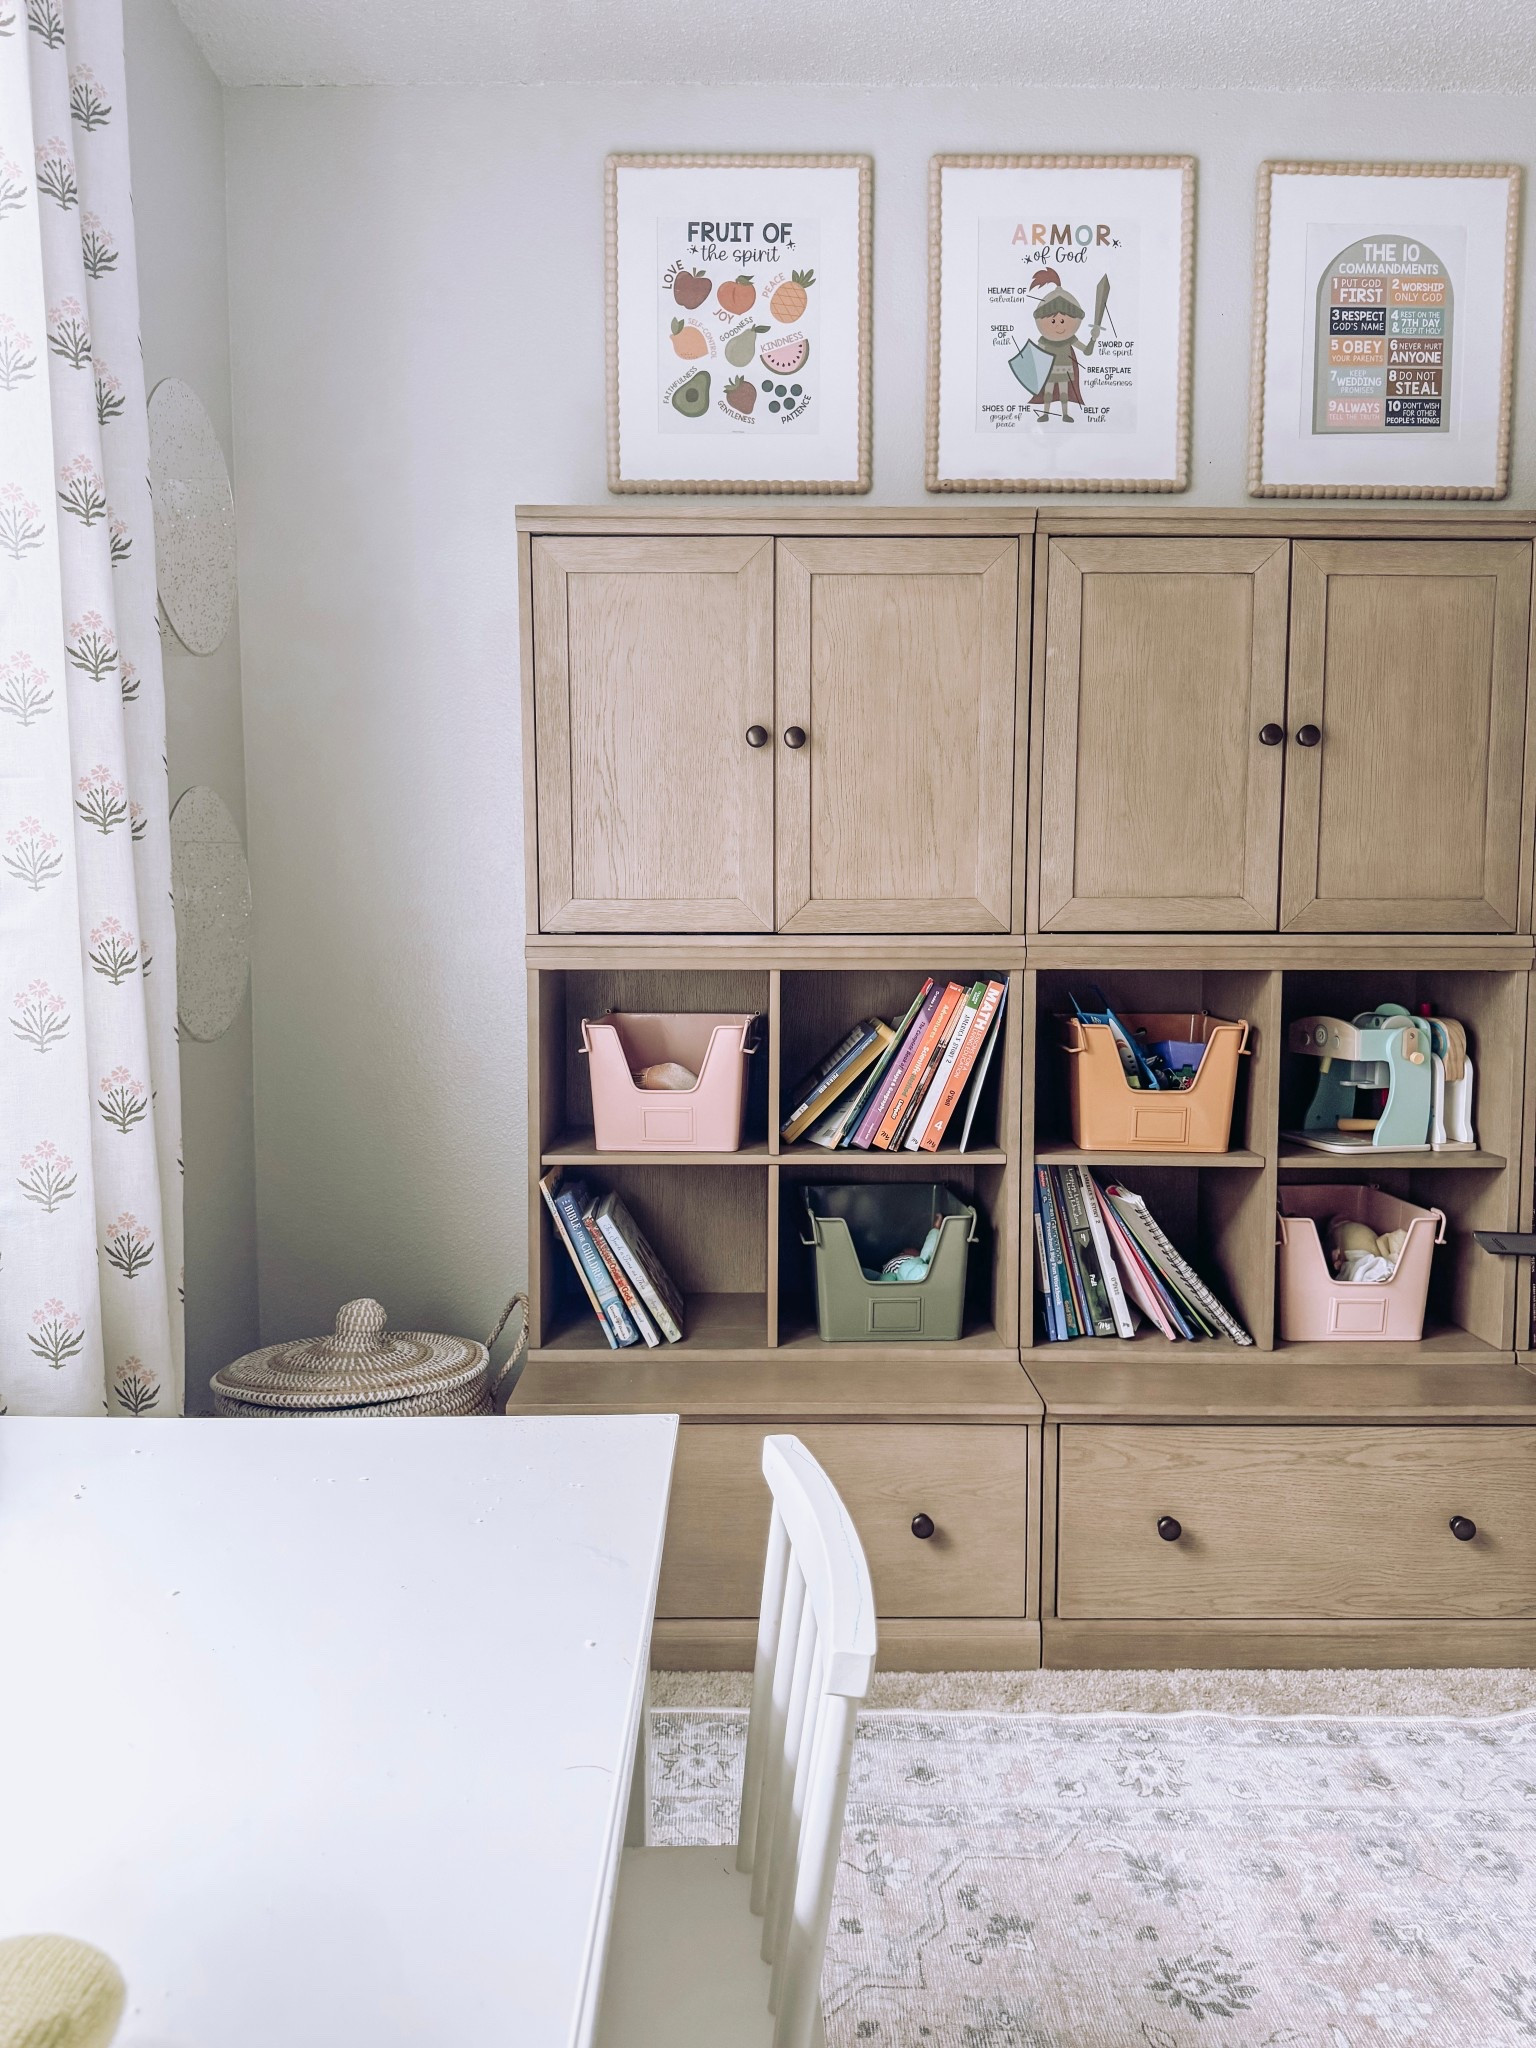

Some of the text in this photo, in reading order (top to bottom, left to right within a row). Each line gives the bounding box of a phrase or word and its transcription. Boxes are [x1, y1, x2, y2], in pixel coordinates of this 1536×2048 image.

[688, 222, 792, 243] FRUIT OF
[1012, 224, 1110, 246] ARMOR
[701, 244, 780, 267] the spirit
[1033, 246, 1088, 264] of God
[1363, 244, 1420, 261] THE 10
[662, 260, 684, 289] LOVE
[1339, 263, 1439, 275] COMMANDMENTS
[762, 272, 786, 299] PEACE
[1333, 278, 1381, 289] 1 PUT GOD
[1392, 279, 1444, 291] 2 WORSHIP
[990, 295, 1024, 303] salvation
[1340, 288, 1383, 302] FIRST
[1395, 293, 1442, 301] ONLY GOD
[713, 309, 734, 324] JOY
[1332, 310, 1384, 321] 3 RESPECT
[1391, 310, 1399, 320] 4
[720, 316, 754, 342] GOODNESS
[1362, 323, 1384, 331] NAME
[1392, 322, 1399, 332] &
[1401, 319, 1440, 328] 7TH DAY
[688, 318, 717, 359] SELF-CONTROL
[760, 331, 804, 352] KINDNESS
[1390, 340, 1397, 350] 6
[1112, 349, 1133, 358] spirit
[1332, 340, 1382, 353] 5 OBEY
[1390, 352, 1441, 363] ANYONE
[1330, 371, 1337, 381] 7
[1337, 378, 1381, 386] WEDDING
[1389, 371, 1436, 381] 8 DO NOT
[663, 366, 698, 403] FAITHFULNESS
[1396, 382, 1438, 395] STEAL
[718, 401, 755, 424] GENTLENESS
[781, 394, 811, 424] PATIENCE
[1329, 401, 1380, 413] 9 ALWAYS
[1388, 401, 1400, 411] 10
[990, 413, 1012, 421] gospel
[974, 988, 999, 1031] MATH
[930, 1004, 948, 1038] Adventures
[907, 1029, 921, 1050] Complete
[969, 1030, 982, 1052] LESSONS
[901, 1050, 910, 1063] Book
[910, 1045, 929, 1075] Scientific
[953, 1045, 970, 1078] EDUCATION
[891, 1068, 902, 1082] Maps
[876, 1086, 893, 1112] Geography
[934, 1120, 943, 1131] 4
[564, 1204, 581, 1230] BIBLE
[576, 1230, 585, 1241] FOR
[581, 1242, 605, 1285] CHILDREN
[1045, 1222, 1054, 1251] Preschool
[1052, 1275, 1061, 1305] Workbook
[621, 1286, 633, 1302] God
